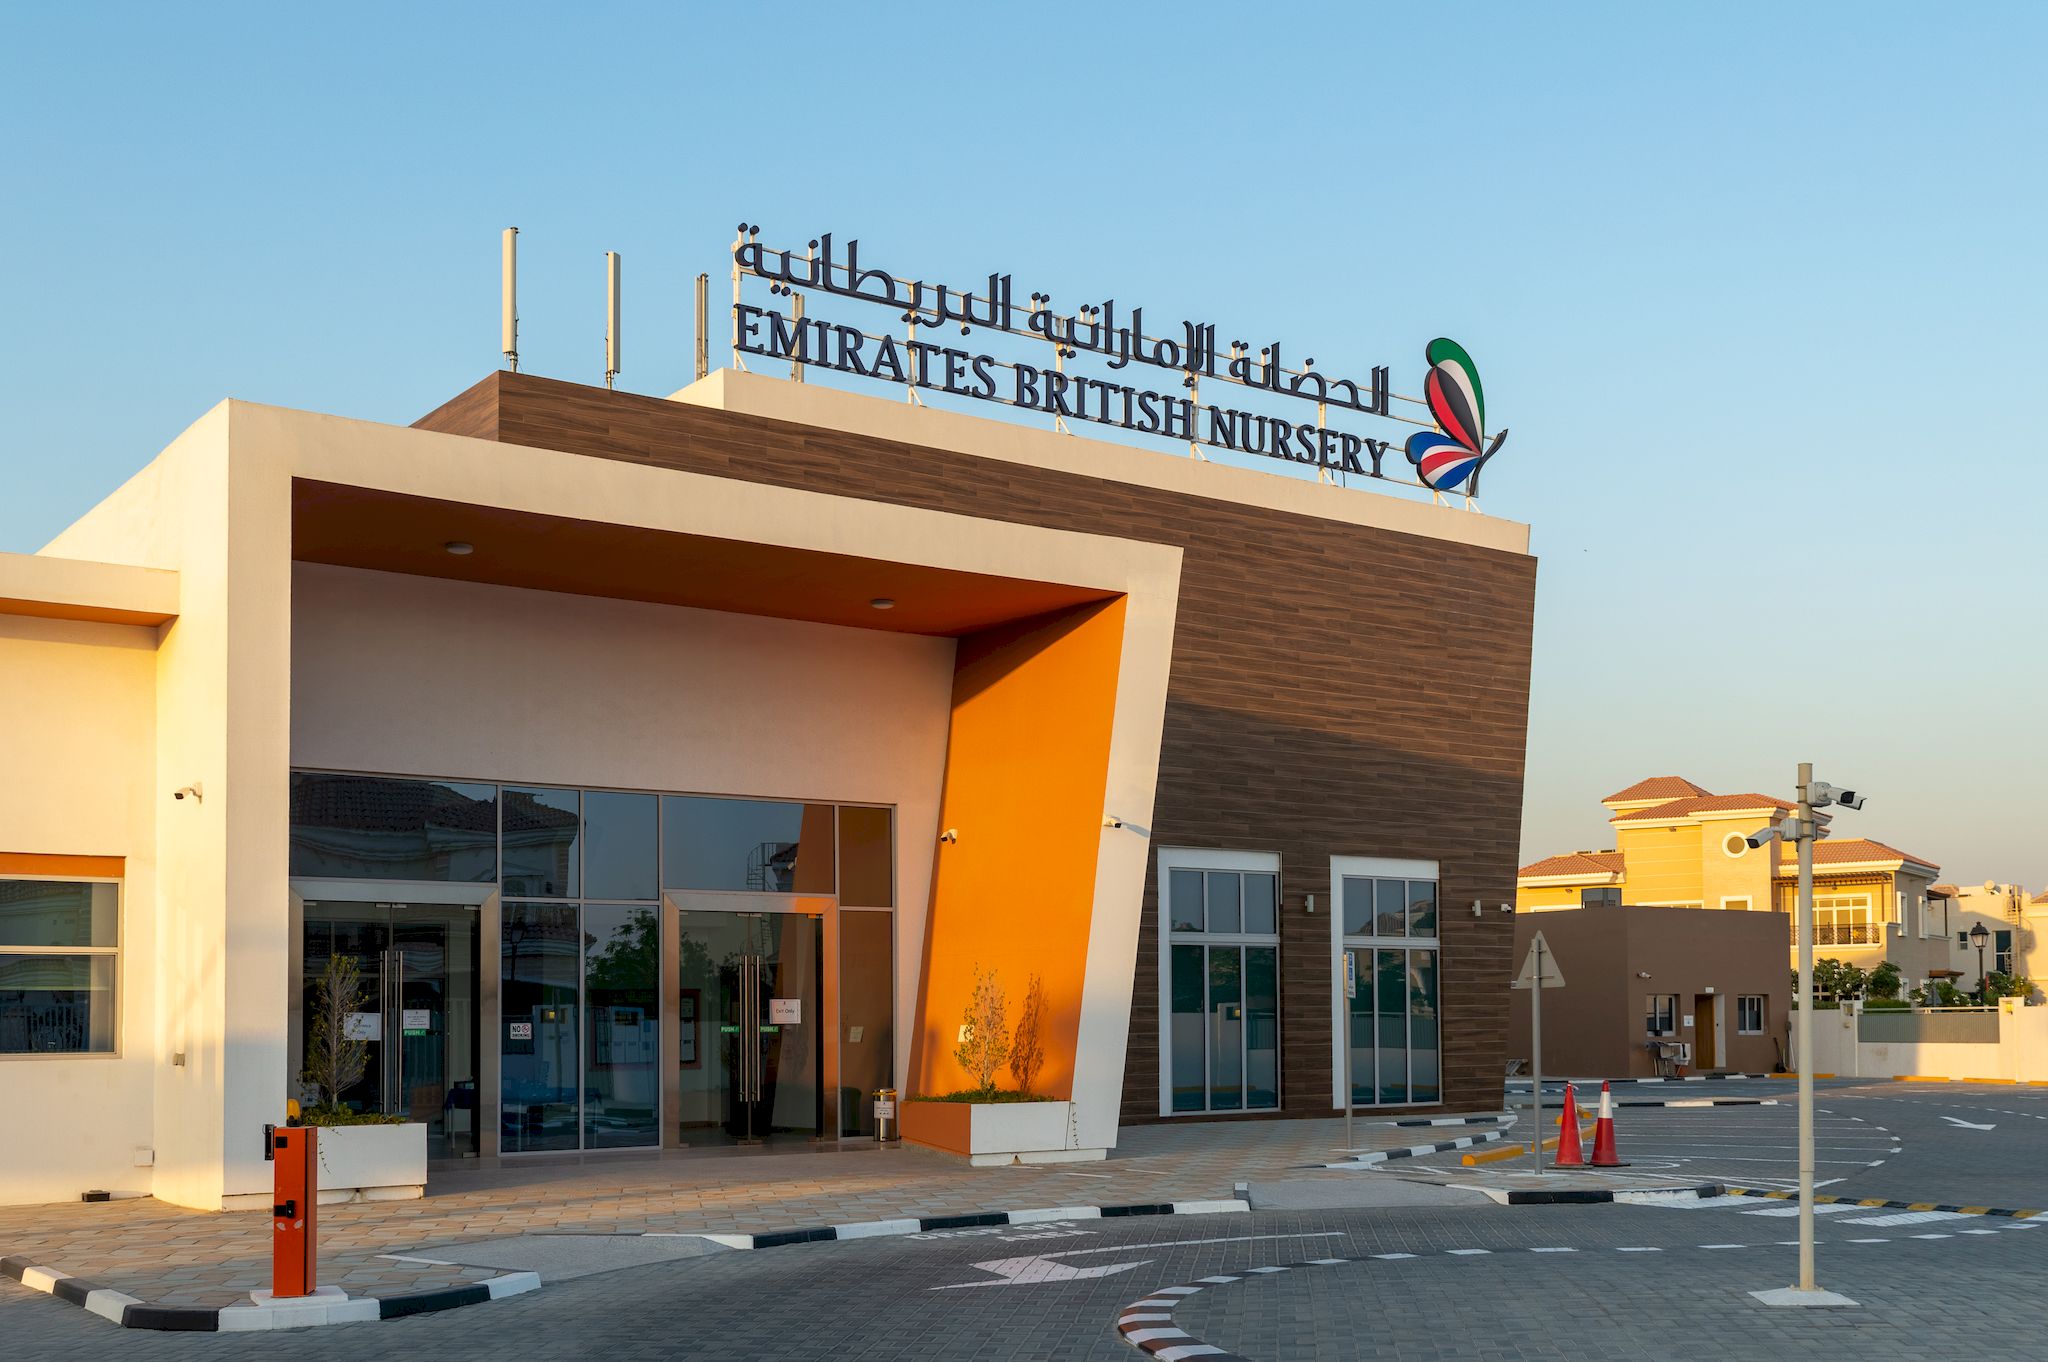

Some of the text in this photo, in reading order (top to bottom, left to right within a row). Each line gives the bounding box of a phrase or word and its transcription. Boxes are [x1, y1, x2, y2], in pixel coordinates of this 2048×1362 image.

[734, 222, 1389, 416] الحضانة الإماراتية البريطانية
[734, 303, 1389, 477] EMIRATES BRITISH NURSERY
[512, 1025, 521, 1033] NO
